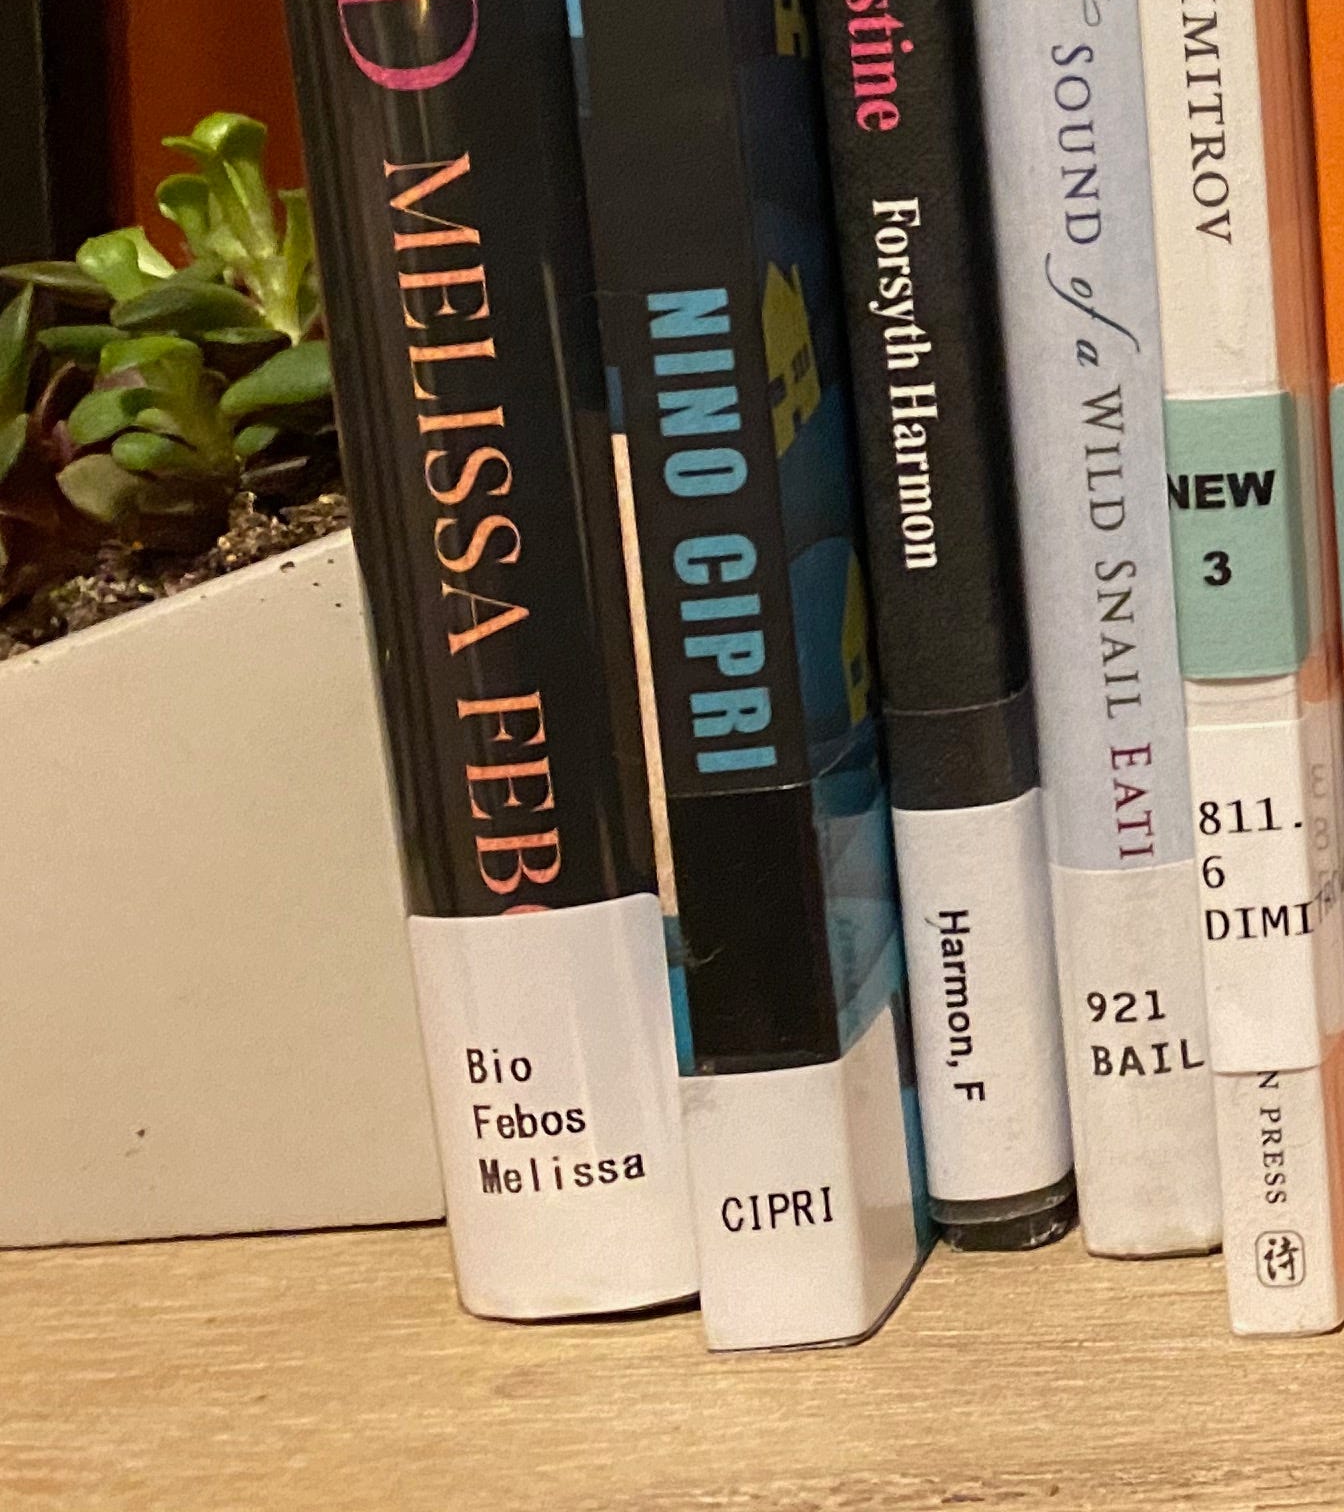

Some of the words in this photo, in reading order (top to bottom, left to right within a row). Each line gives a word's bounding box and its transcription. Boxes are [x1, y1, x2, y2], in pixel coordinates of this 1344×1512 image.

[1051, 43, 1103, 246] SOUND
[872, 197, 934, 371] Forsyth
[1044, 252, 1142, 352] of
[1076, 337, 1099, 368] a
[383, 151, 530, 657] MELISSA
[647, 288, 749, 497] NINO
[891, 379, 940, 571] Harmon
[1079, 385, 1130, 534] WILD
[1166, 469, 1276, 510] NEW
[1203, 550, 1232, 586] 3
[673, 533, 777, 776] CIPRI
[1095, 559, 1142, 719] SNAIL
[456, 690, 563, 915] FEB
[1198, 796, 1304, 835] 811.
[1202, 855, 1225, 888] 6
[937, 910, 974, 1069] Harmon,
[1086, 990, 1166, 1024] 921
[466, 1048, 532, 1085] Bio
[951, 1081, 986, 1103] F
[1090, 1035, 1206, 1078] BAIL
[474, 1102, 586, 1140] Febos
[1259, 1107, 1287, 1204] PRESS
[479, 1150, 646, 1194] Melissa
[720, 1187, 835, 1234] CIPRI
